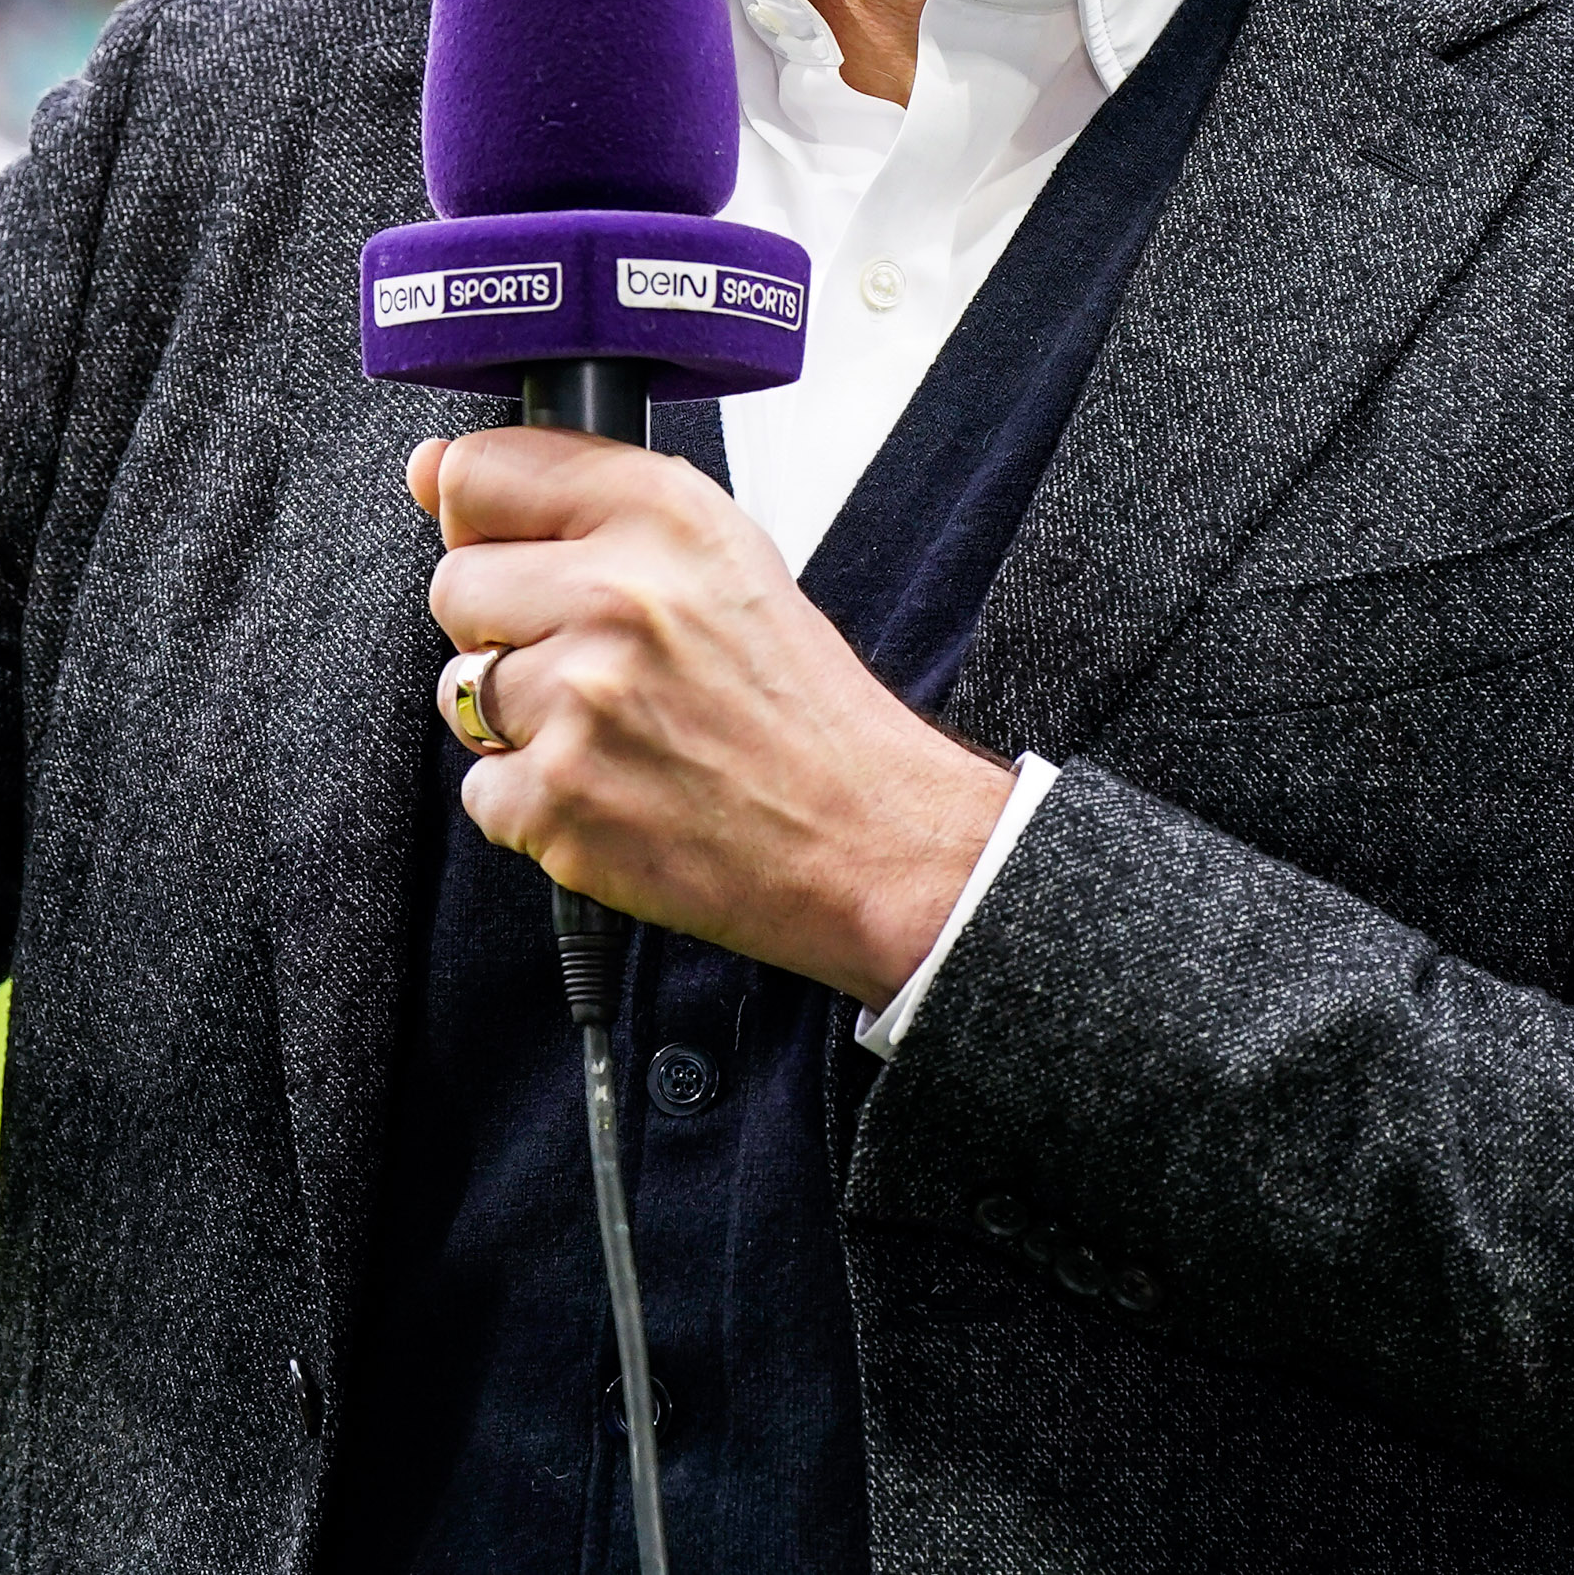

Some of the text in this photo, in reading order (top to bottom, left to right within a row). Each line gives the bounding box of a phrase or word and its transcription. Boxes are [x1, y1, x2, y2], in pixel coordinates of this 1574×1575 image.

[379, 274, 551, 314] beIN SPORTS
[627, 263, 797, 319] beIN SPORTS
